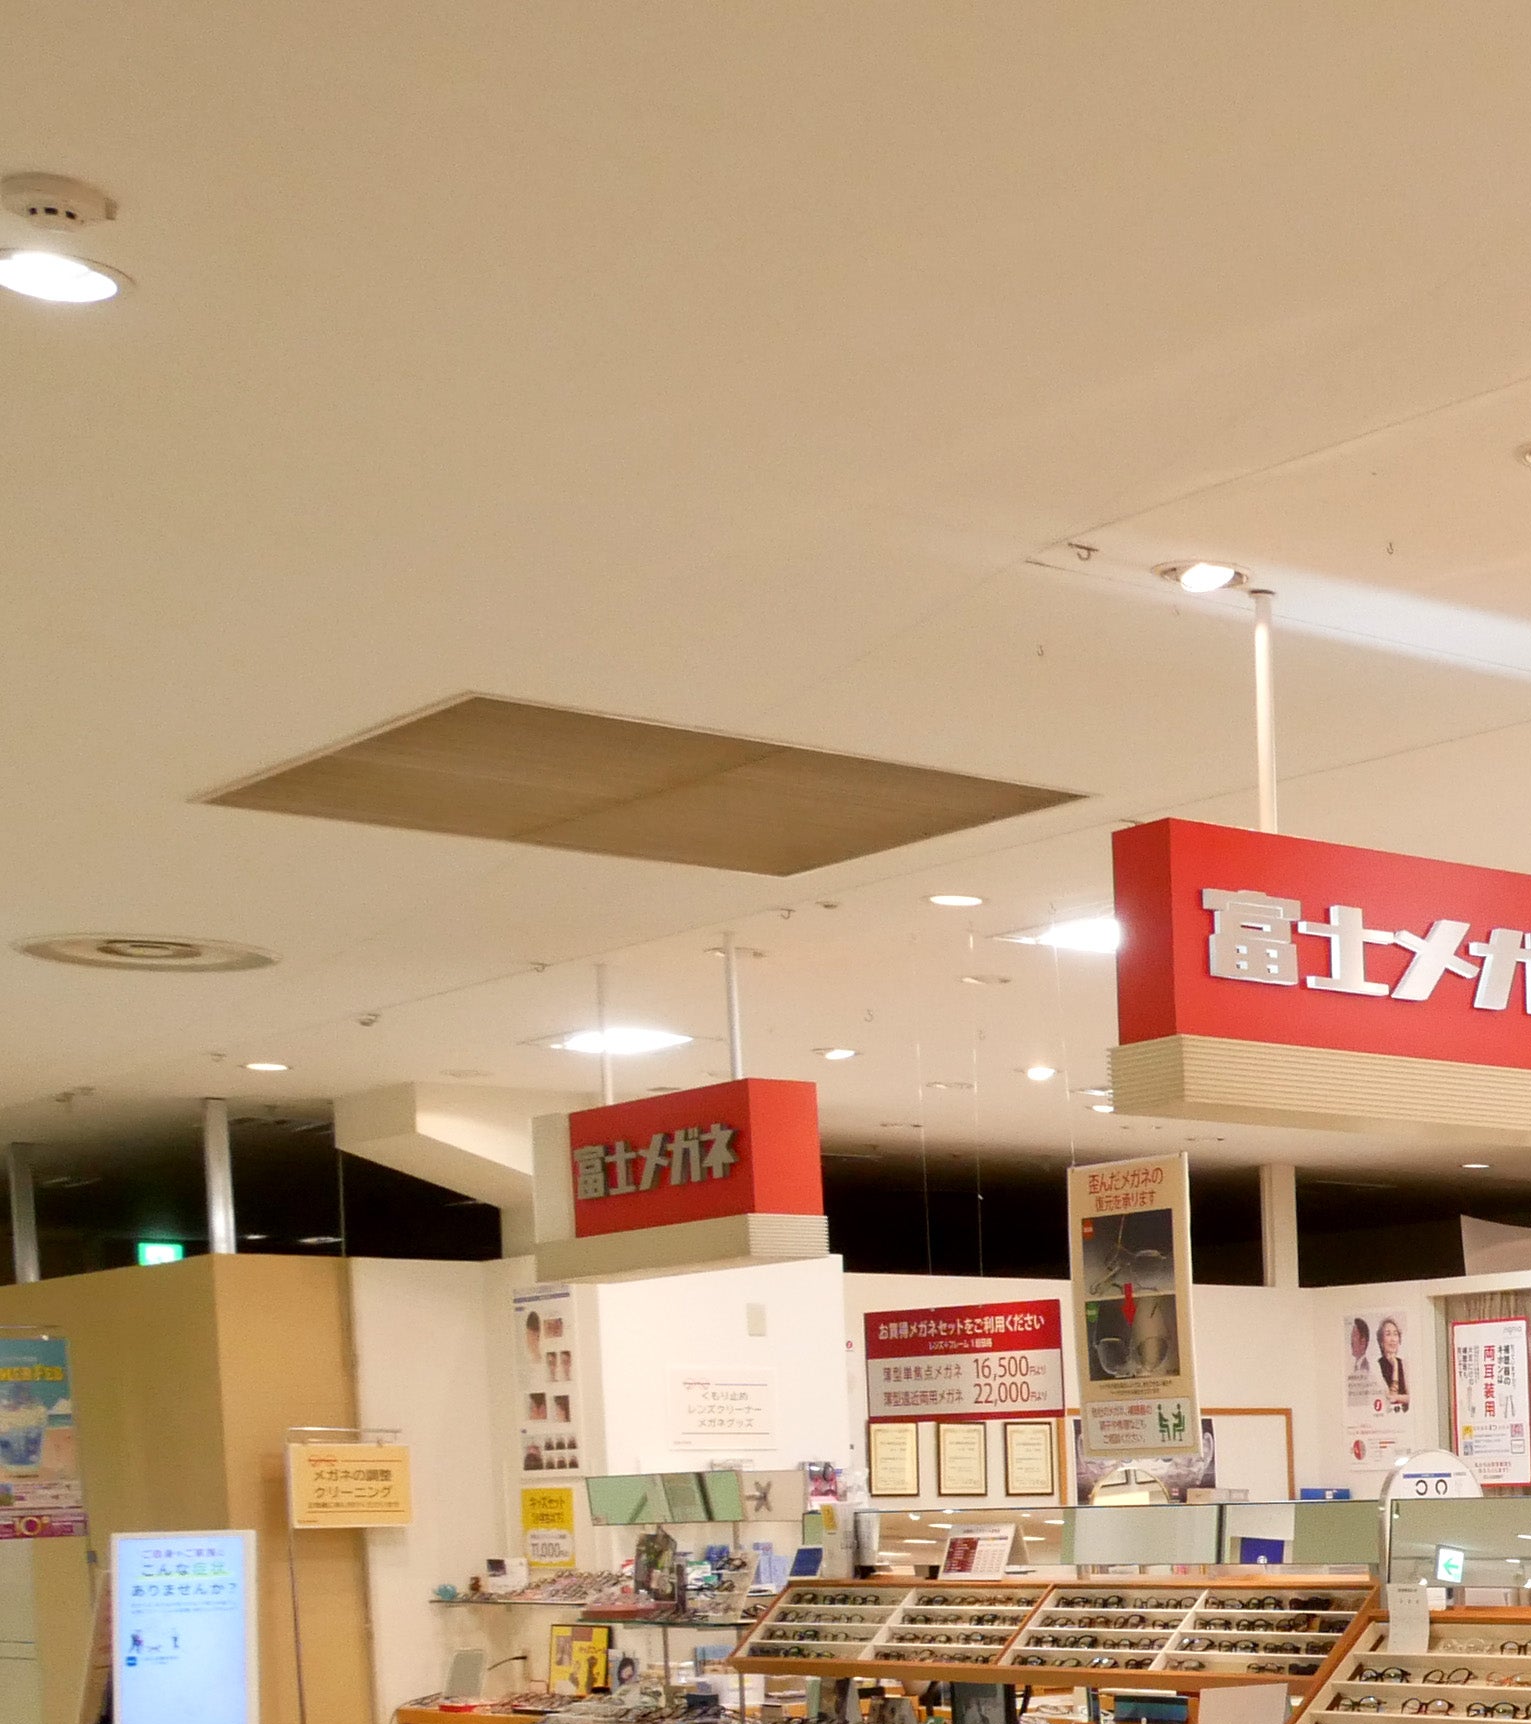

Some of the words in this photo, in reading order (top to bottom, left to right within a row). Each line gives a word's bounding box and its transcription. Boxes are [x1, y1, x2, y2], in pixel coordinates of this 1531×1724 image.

[572, 1123, 740, 1200] 富士メガネ
[1088, 1167, 1164, 1195] 歪んだメガネの
[1094, 1190, 1157, 1213] 復元を承ります
[877, 1313, 1046, 1341] お買得メガネセットをご利用ください
[1483, 1344, 1496, 1418] 両耳装用
[314, 1469, 393, 1482] メガネの調整
[314, 1486, 394, 1499] クリーニング
